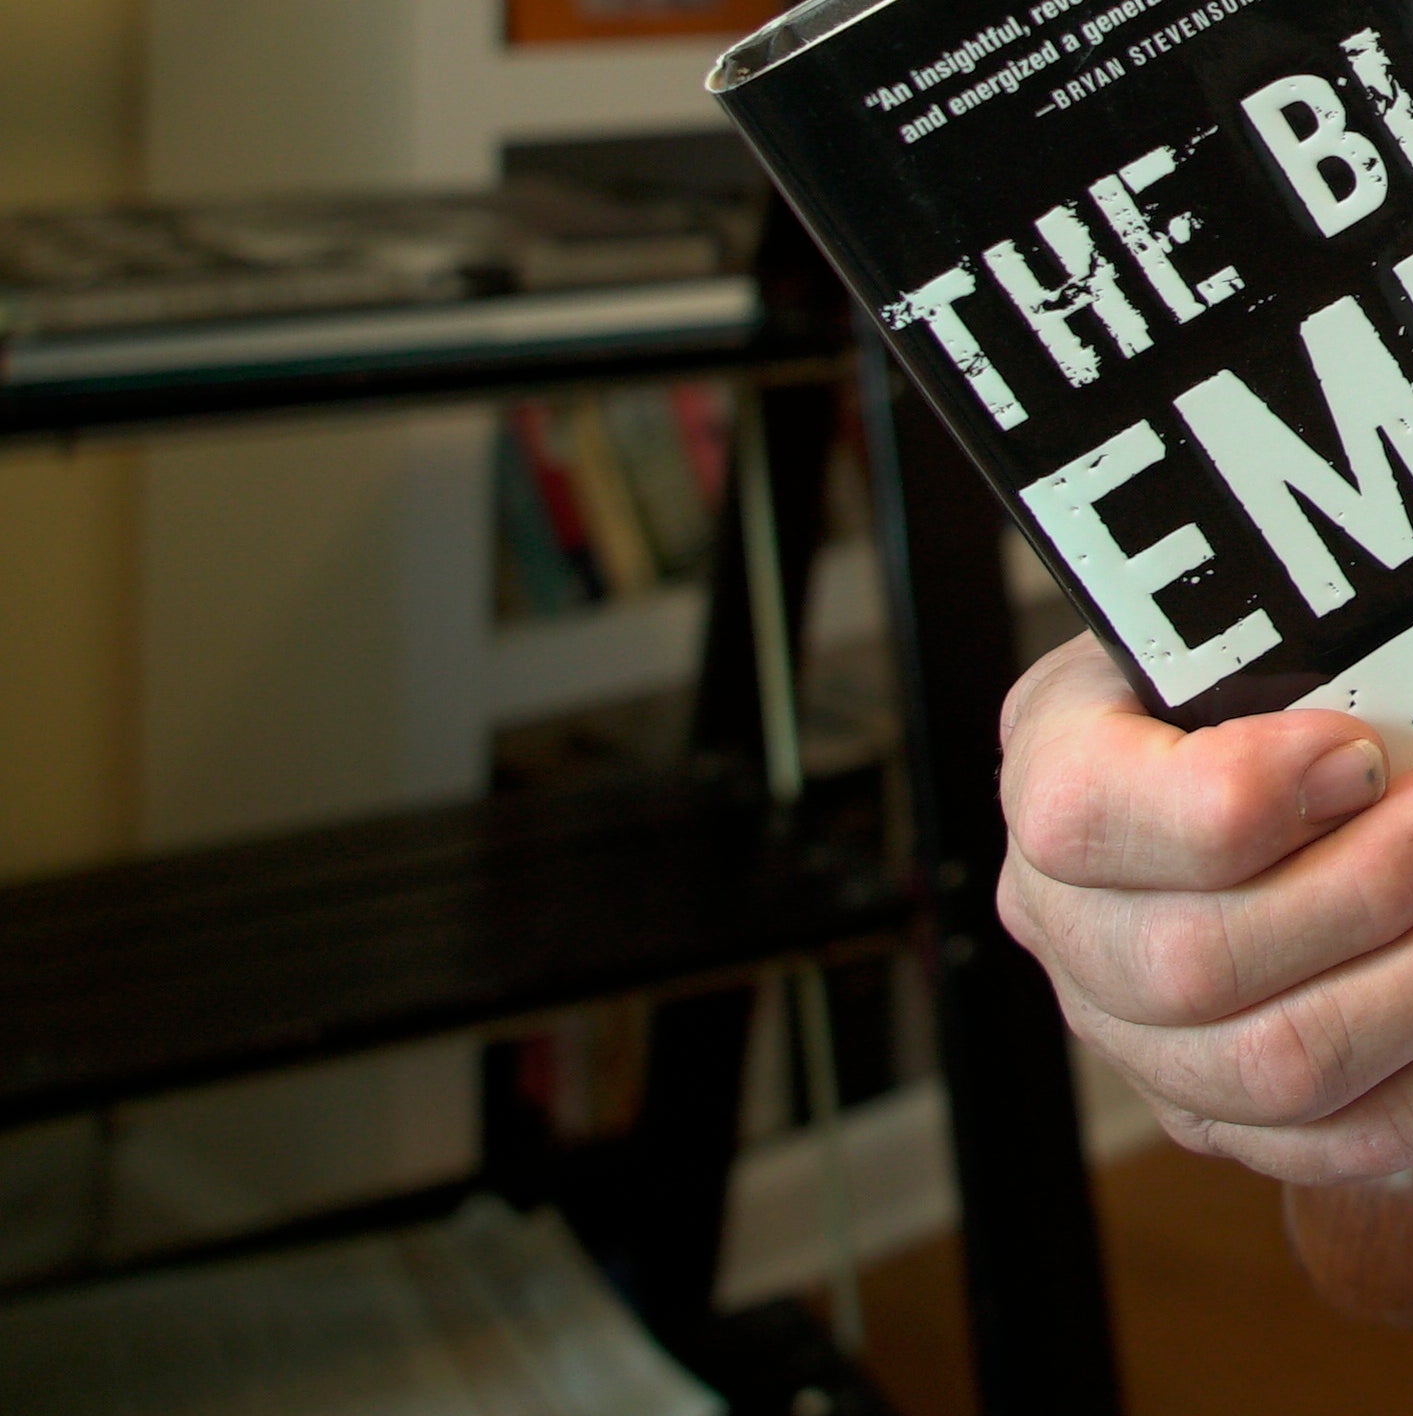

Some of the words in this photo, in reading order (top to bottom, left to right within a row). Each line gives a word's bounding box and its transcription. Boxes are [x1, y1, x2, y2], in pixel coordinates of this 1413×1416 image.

[901, 104, 947, 143] and
[948, 40, 1060, 115] energized
[1062, 33, 1081, 52] a
[911, 16, 1030, 90] insightful,
[883, 146, 1245, 431] THE
